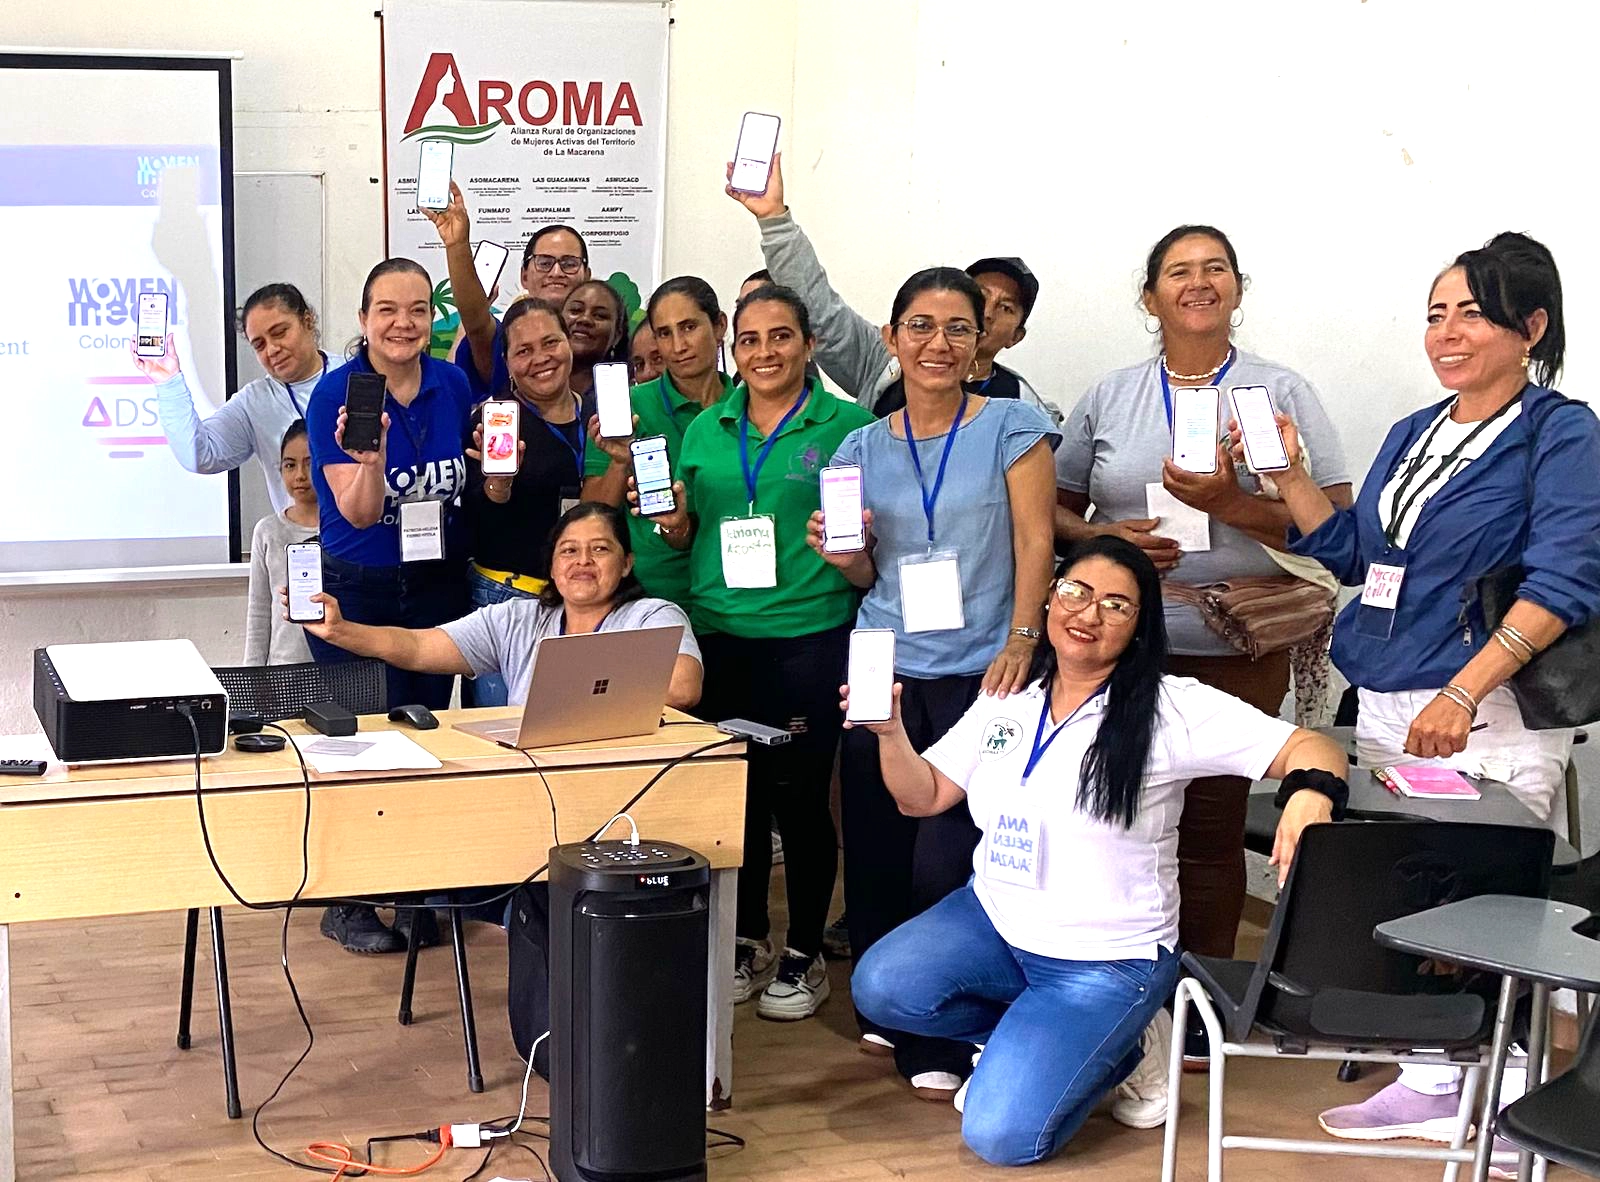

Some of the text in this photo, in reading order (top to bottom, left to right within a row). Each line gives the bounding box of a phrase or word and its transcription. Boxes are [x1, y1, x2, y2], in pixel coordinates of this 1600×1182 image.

[403, 53, 643, 134] AROMA
[510, 127, 637, 136] Alianza Rural de Organizaciones
[510, 137, 636, 147] de Mujeres Activas del Territorio
[543, 148, 605, 156] de La Macarena
